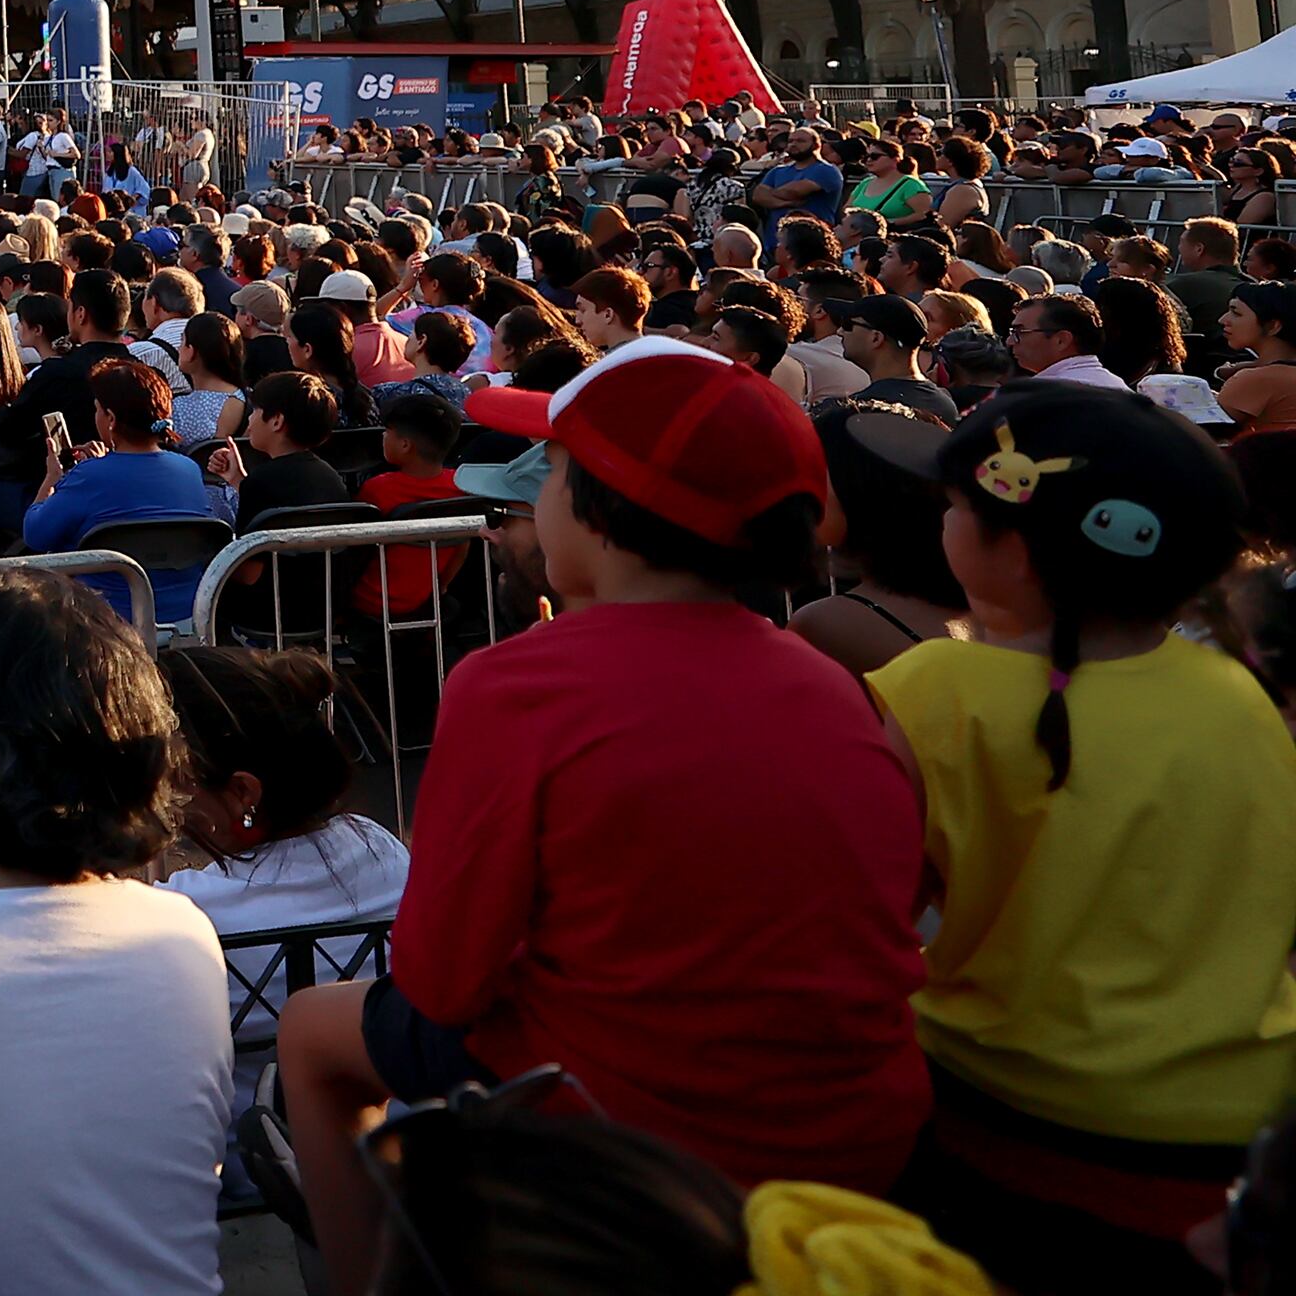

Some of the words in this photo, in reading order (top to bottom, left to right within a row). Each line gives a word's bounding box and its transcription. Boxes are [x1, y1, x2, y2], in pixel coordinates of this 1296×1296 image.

[623, 10, 648, 89] Alameda
[358, 73, 395, 100] GS
[399, 85, 436, 93] SANTIAGO
[1109, 89, 1127, 98] GS
